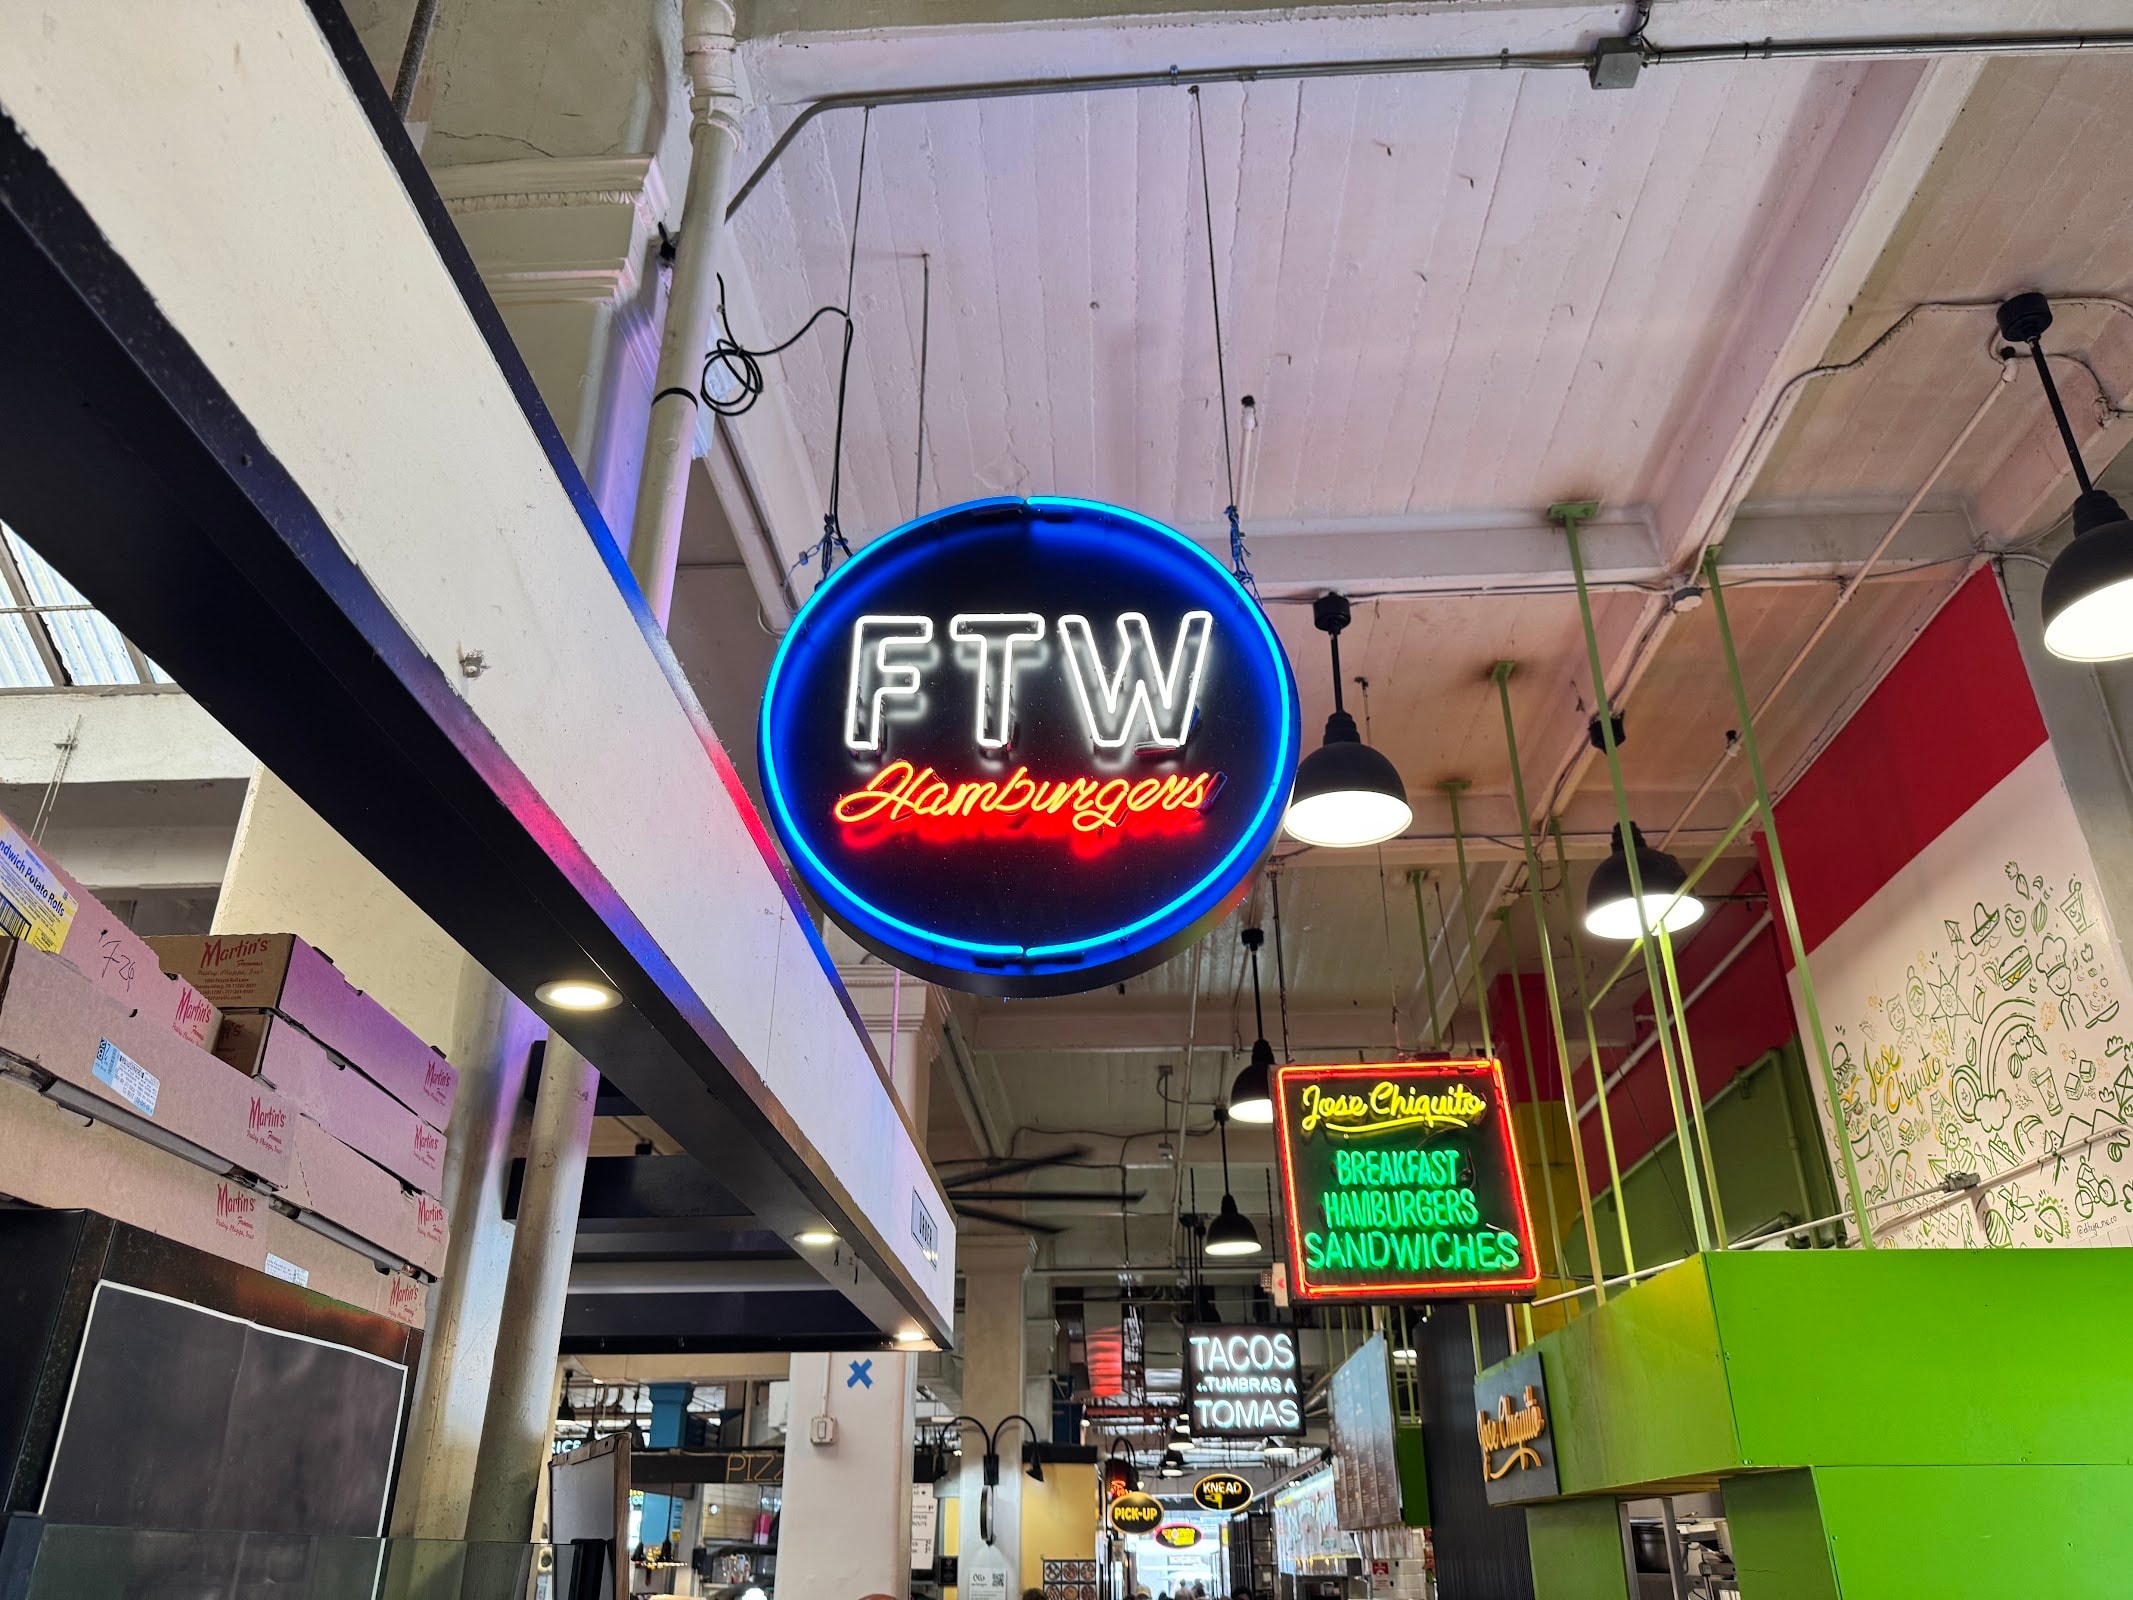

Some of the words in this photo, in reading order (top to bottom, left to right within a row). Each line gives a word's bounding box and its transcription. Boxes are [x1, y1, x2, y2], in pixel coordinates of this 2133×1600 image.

[845, 610, 1213, 750] FTW
[834, 761, 1210, 832] Hamburgers
[24, 867, 49, 899] Potato
[47, 892, 65, 917] Rolls
[200, 938, 270, 969] Martin's
[176, 986, 212, 1024] Martin's
[424, 1060, 451, 1088] Martin's
[1863, 1041, 1902, 1106] Jose
[1886, 1042, 1943, 1116] Chiquito
[249, 1096, 287, 1132] Martin's
[1302, 1084, 1369, 1131] Jose
[1370, 1081, 1487, 1128] Chiquito
[413, 1124, 439, 1151] Martin's
[1336, 1149, 1460, 1186] BREAKFAST
[215, 1183, 256, 1218] Martin's
[1323, 1187, 1479, 1229] HAMBURGERS
[1304, 1230, 1521, 1270] SANDWICHES
[389, 1276, 418, 1308] Martin's
[1189, 1333, 1296, 1373] TACOS
[1284, 1377, 1298, 1395] A
[1193, 1399, 1300, 1430] TOMAS
[1477, 1410, 1499, 1483] Jose
[1203, 1482, 1242, 1495] KNEAD
[1114, 1507, 1158, 1521] PICK-UP
